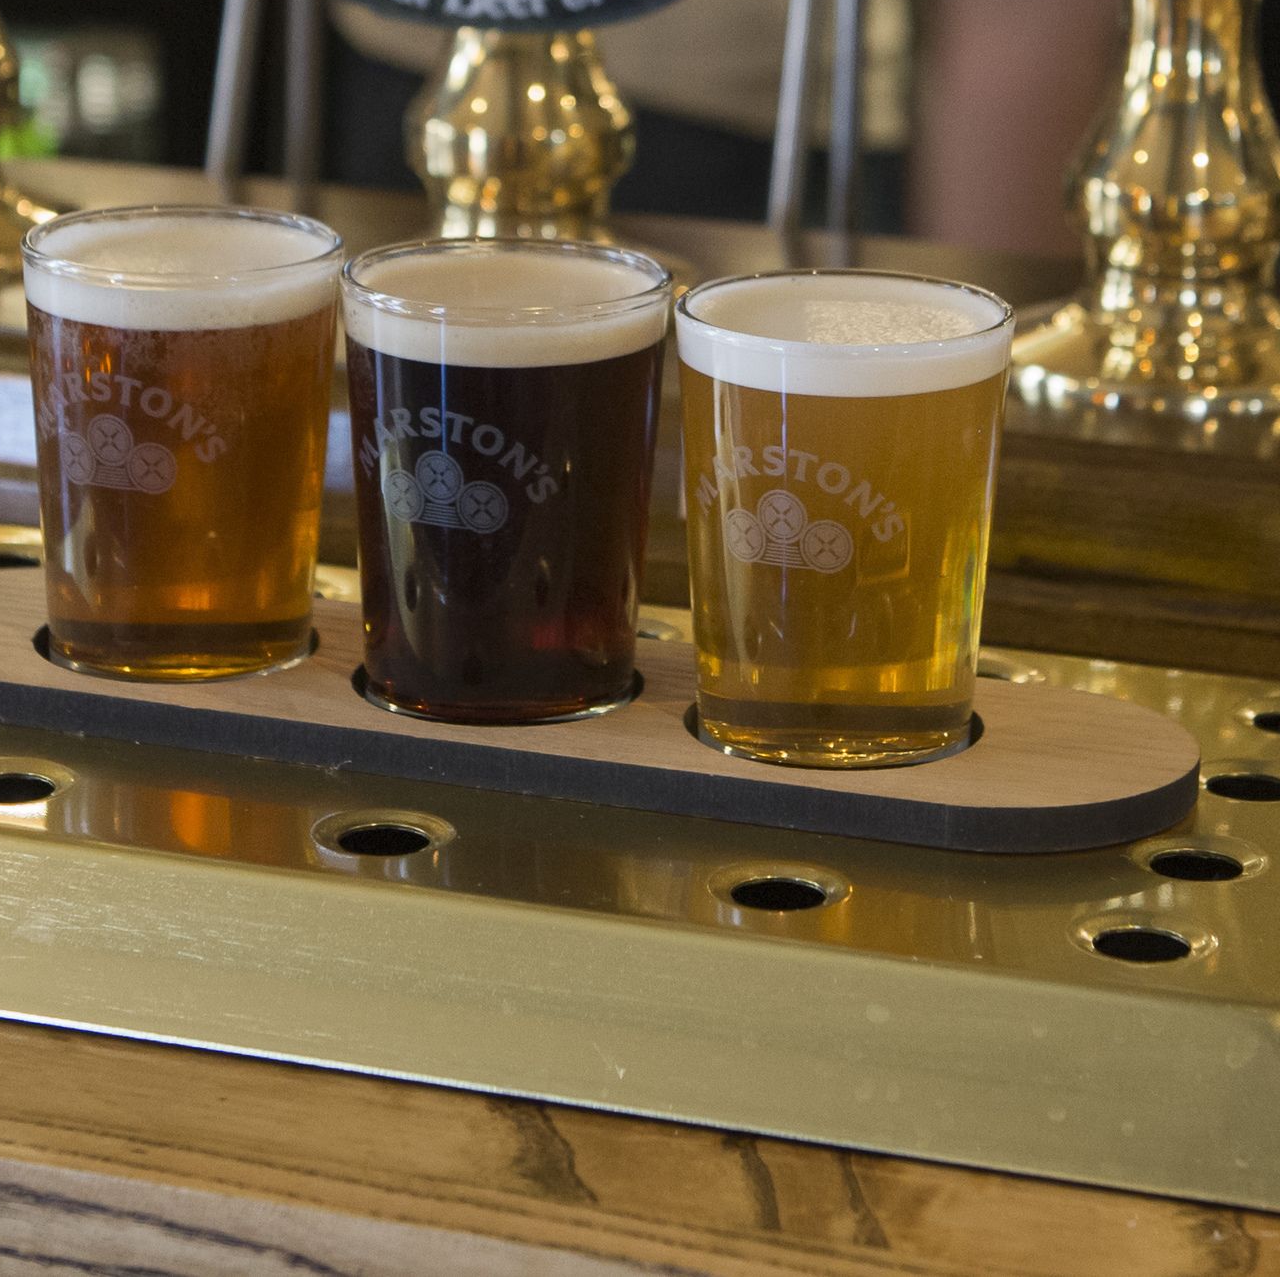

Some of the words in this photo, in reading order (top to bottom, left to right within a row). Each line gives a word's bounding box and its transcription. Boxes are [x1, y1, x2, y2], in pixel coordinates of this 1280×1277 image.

[39, 371, 227, 464] MARSTON'S
[359, 407, 560, 505] MARSTON'S
[696, 445, 906, 543] MARSTON'S
